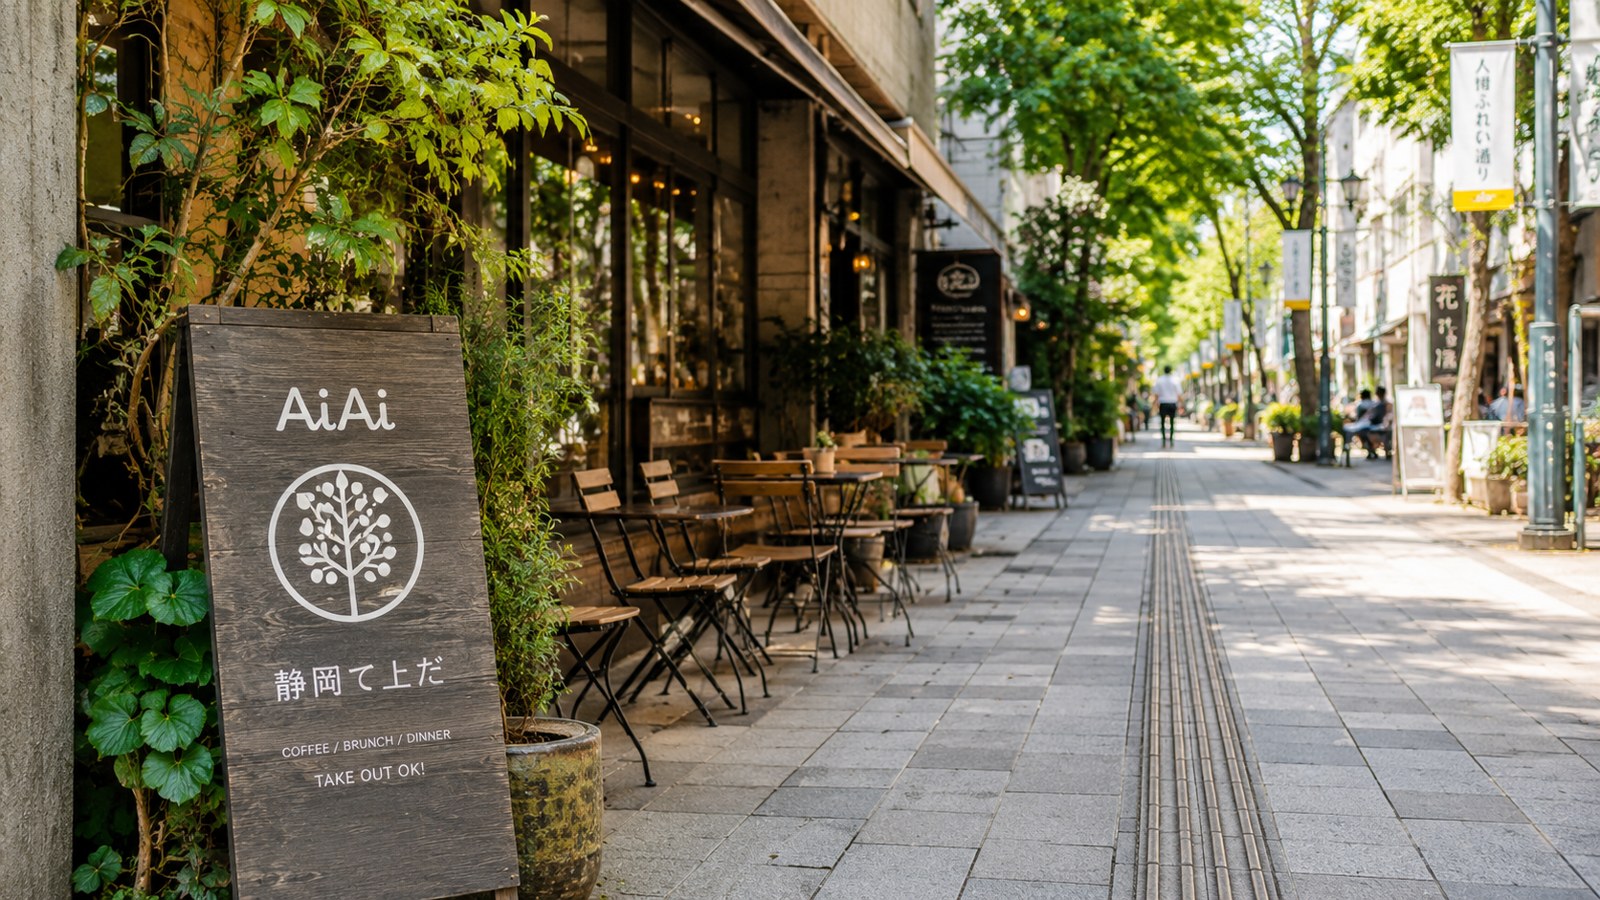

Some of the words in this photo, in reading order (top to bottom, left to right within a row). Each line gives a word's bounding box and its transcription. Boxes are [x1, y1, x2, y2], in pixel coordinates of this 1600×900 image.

[275, 386, 396, 432] AiAi
[273, 655, 445, 702] 静岡て上だ
[281, 742, 330, 758] COFFEE
[343, 735, 394, 752] BRUNCH
[406, 729, 452, 744] DINNER
[313, 770, 356, 788] TAKE
[360, 765, 393, 783] OUT
[397, 761, 426, 778] OK!
